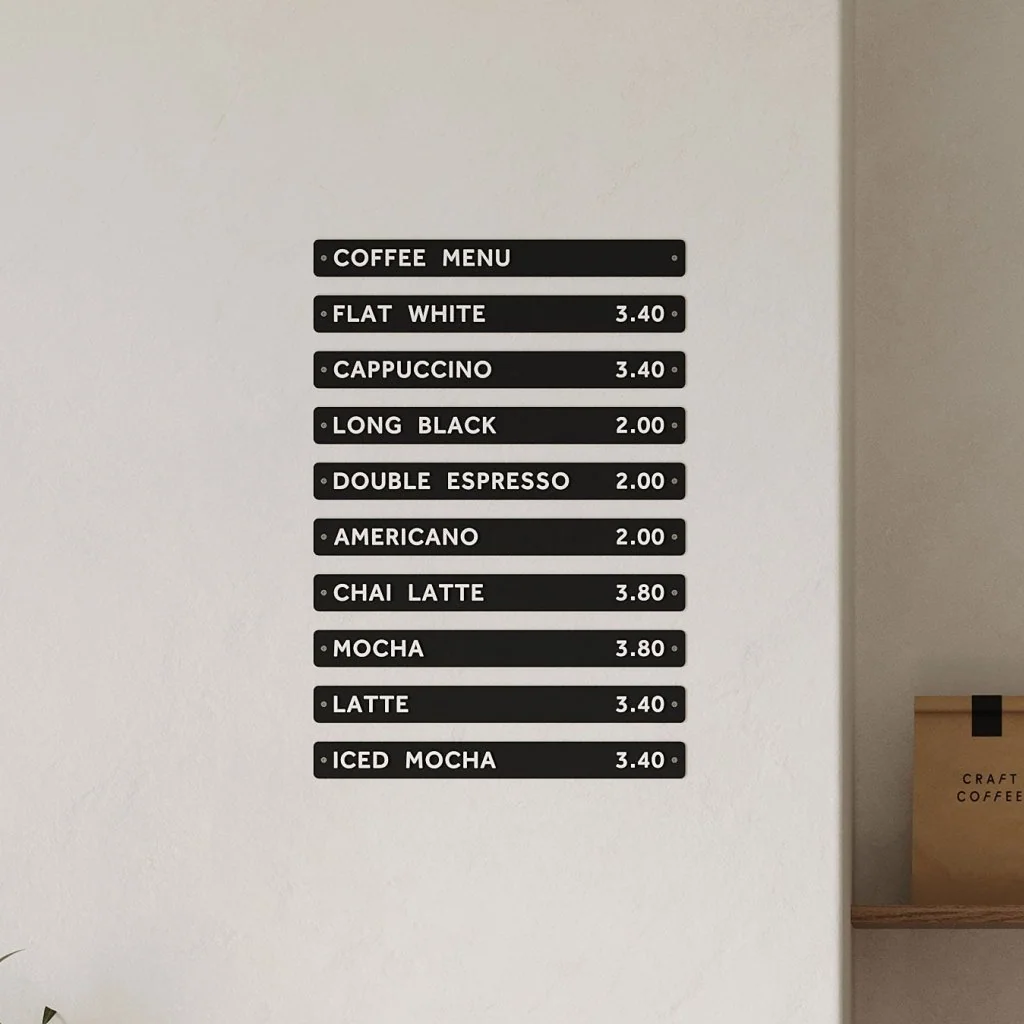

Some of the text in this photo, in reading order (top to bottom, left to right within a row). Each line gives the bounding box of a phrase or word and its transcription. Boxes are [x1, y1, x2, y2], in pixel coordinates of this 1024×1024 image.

[334, 249, 510, 267] COFFEE MENU
[333, 305, 664, 322] FLAT WHITE 3.40
[334, 361, 664, 378] CAPPUCCINO 3.40
[333, 416, 664, 434] LONG BLACK 2.00
[334, 472, 664, 490] DOUBLE ESPRESSO 2.00
[334, 528, 664, 546] AMERICANO 2.00
[334, 584, 664, 601] CHAI LATTE 3.80
[334, 639, 664, 657] MOCHA 3.80
[333, 696, 664, 712] LATTE 3.40
[333, 751, 664, 769] ICED MOCHA 3.40
[962, 773, 1017, 785] CRAFT
[956, 790, 1023, 803] COFFEE
